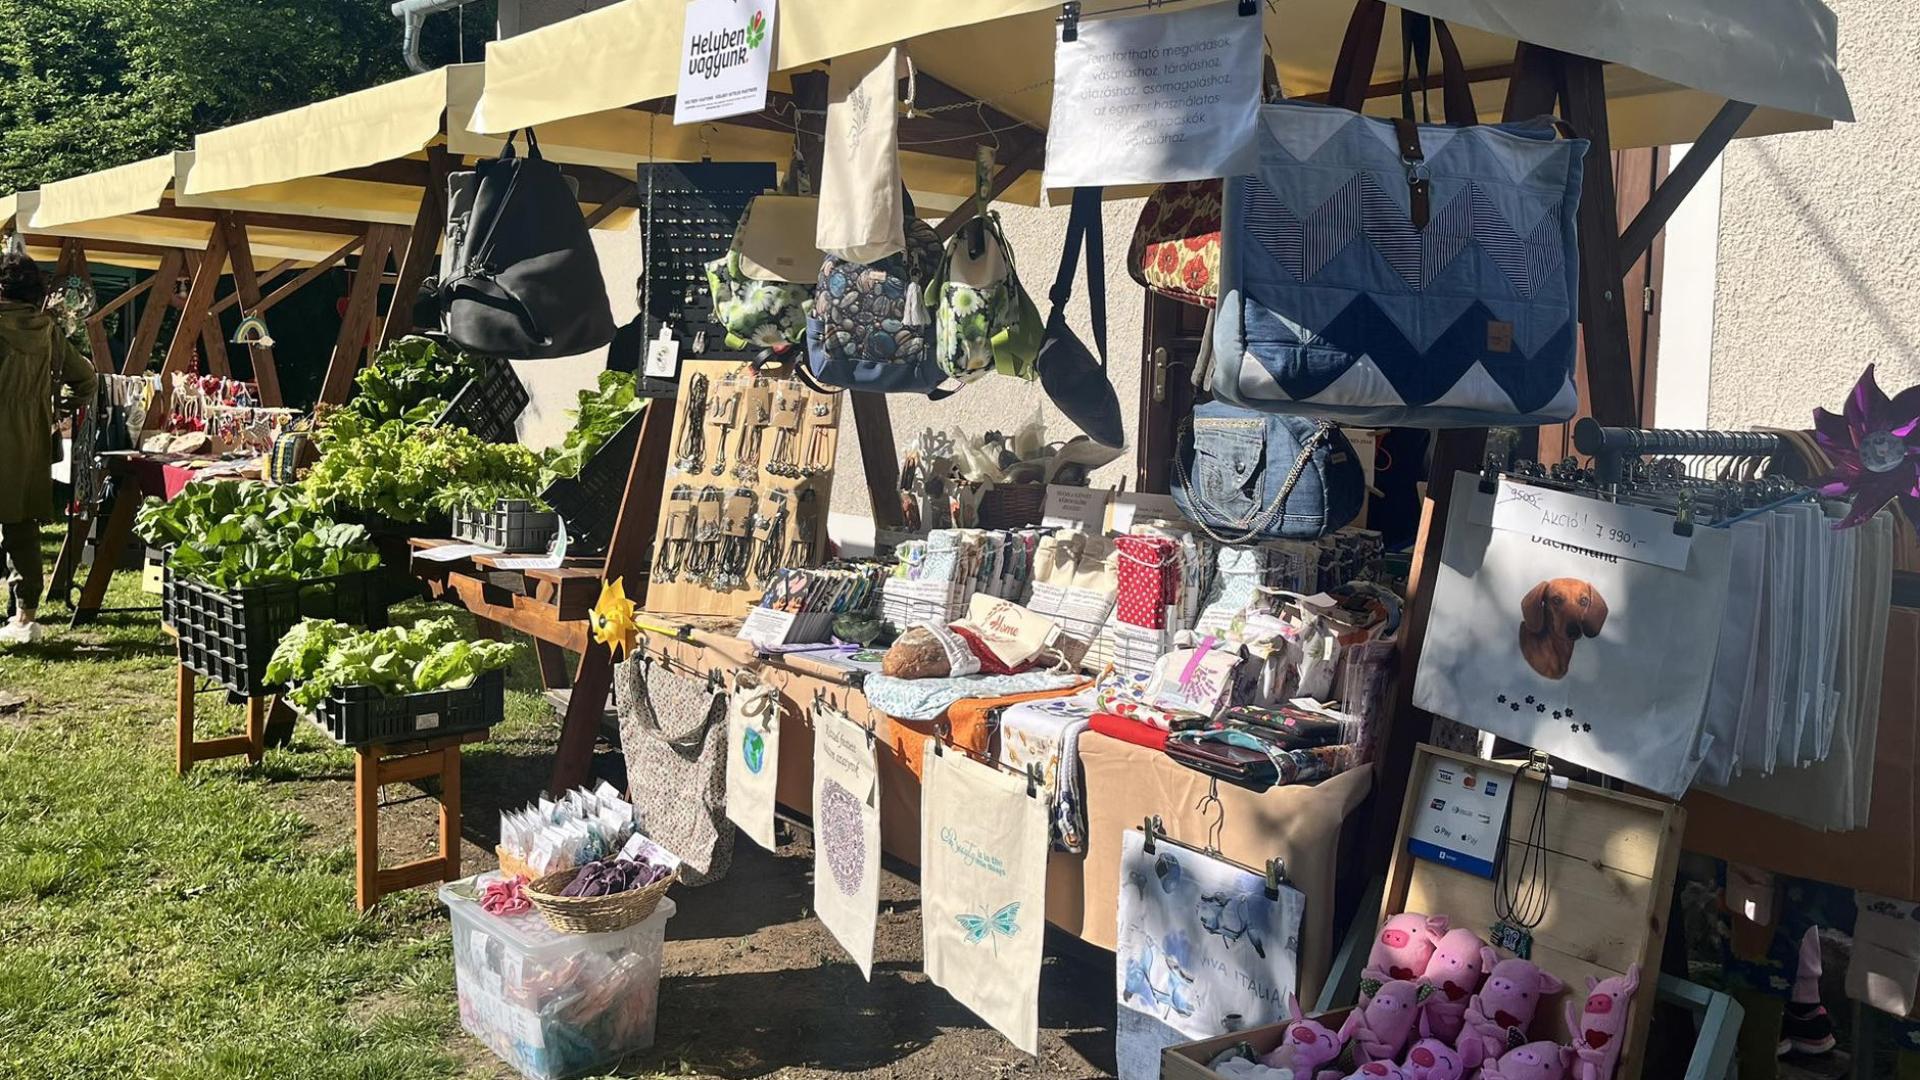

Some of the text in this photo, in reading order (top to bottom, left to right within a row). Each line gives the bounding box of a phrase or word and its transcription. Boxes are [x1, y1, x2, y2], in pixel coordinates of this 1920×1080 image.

[690, 28, 745, 57] Helyben
[1163, 38, 1231, 56] megoldások
[989, 614, 1019, 637] Home
[1200, 958, 1227, 976] VIVA
